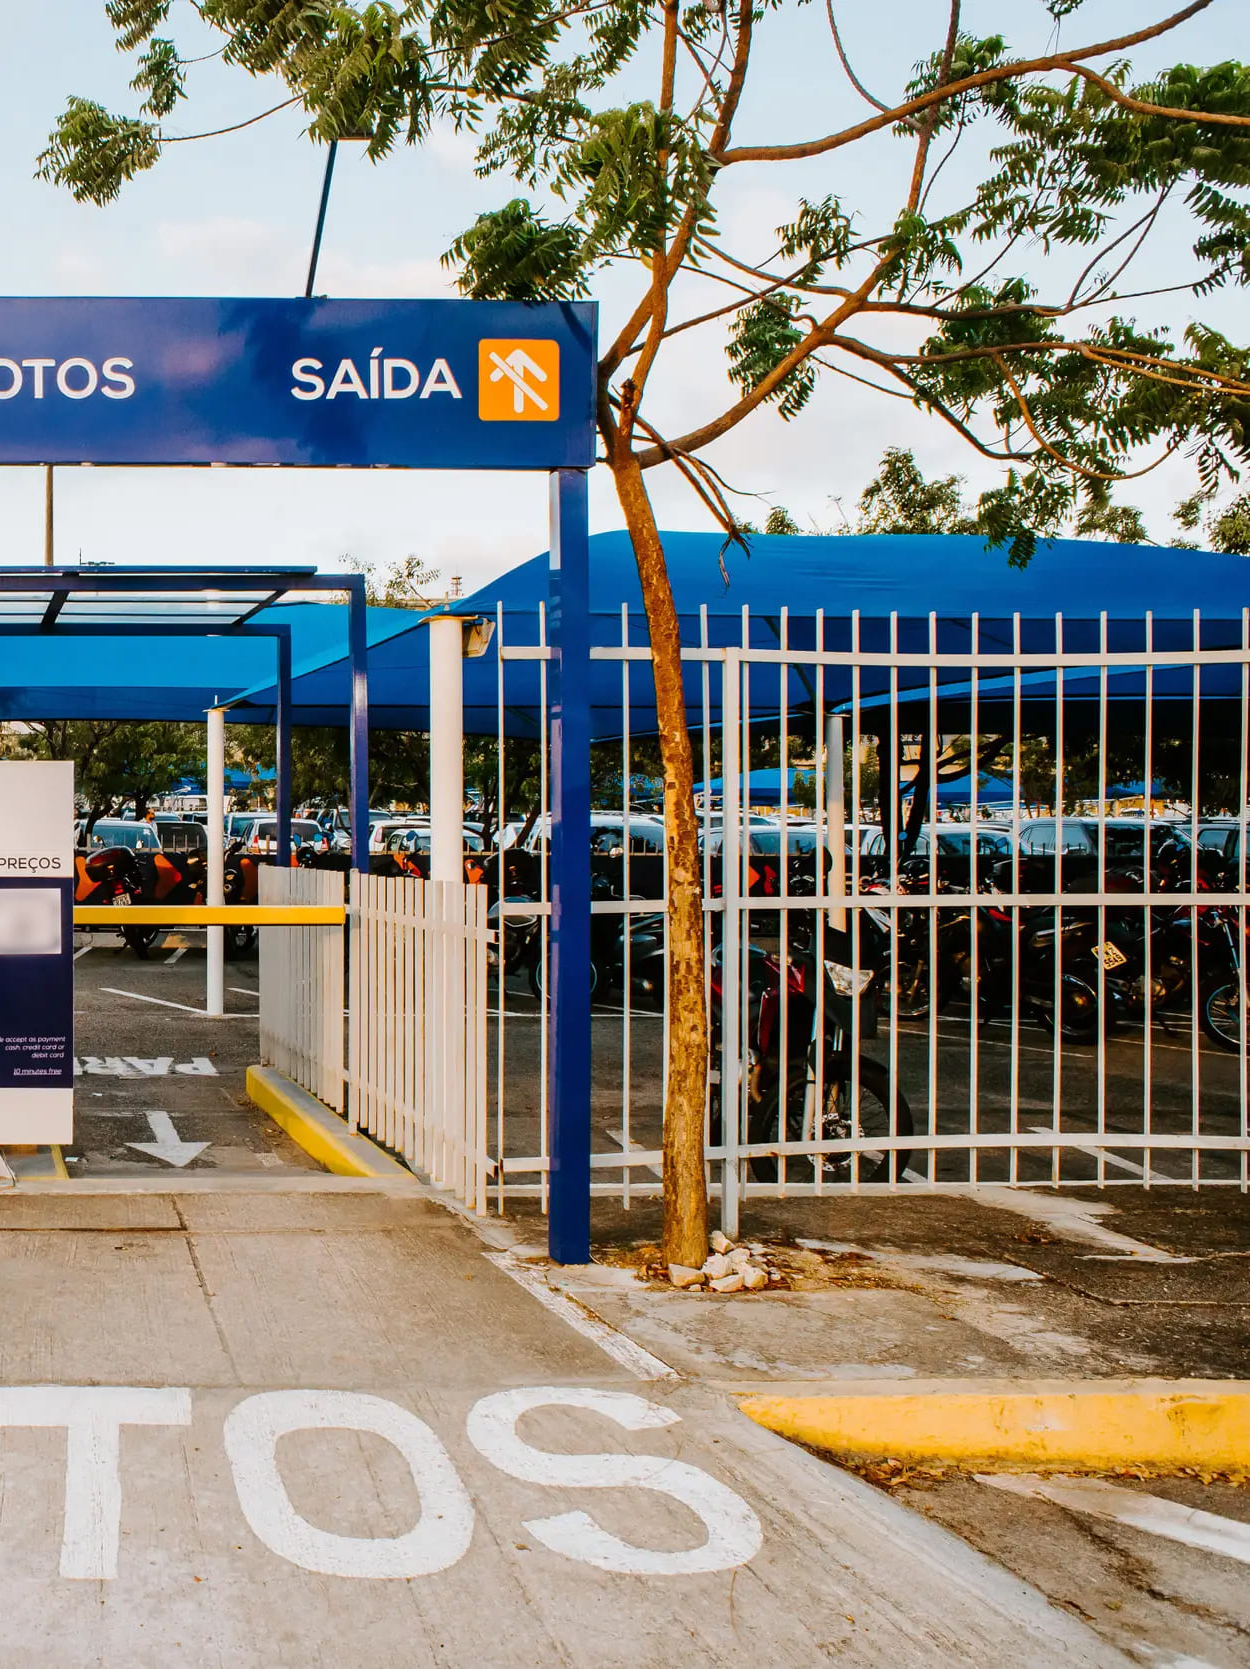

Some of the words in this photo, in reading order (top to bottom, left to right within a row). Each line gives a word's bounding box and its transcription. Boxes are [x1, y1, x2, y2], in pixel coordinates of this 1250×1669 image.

[290, 347, 463, 400] SAÍDA
[13, 1067, 21, 1076] 10
[21, 1068, 47, 1076] minutes
[48, 1067, 63, 1075] free
[74, 1056, 220, 1077] PAR
